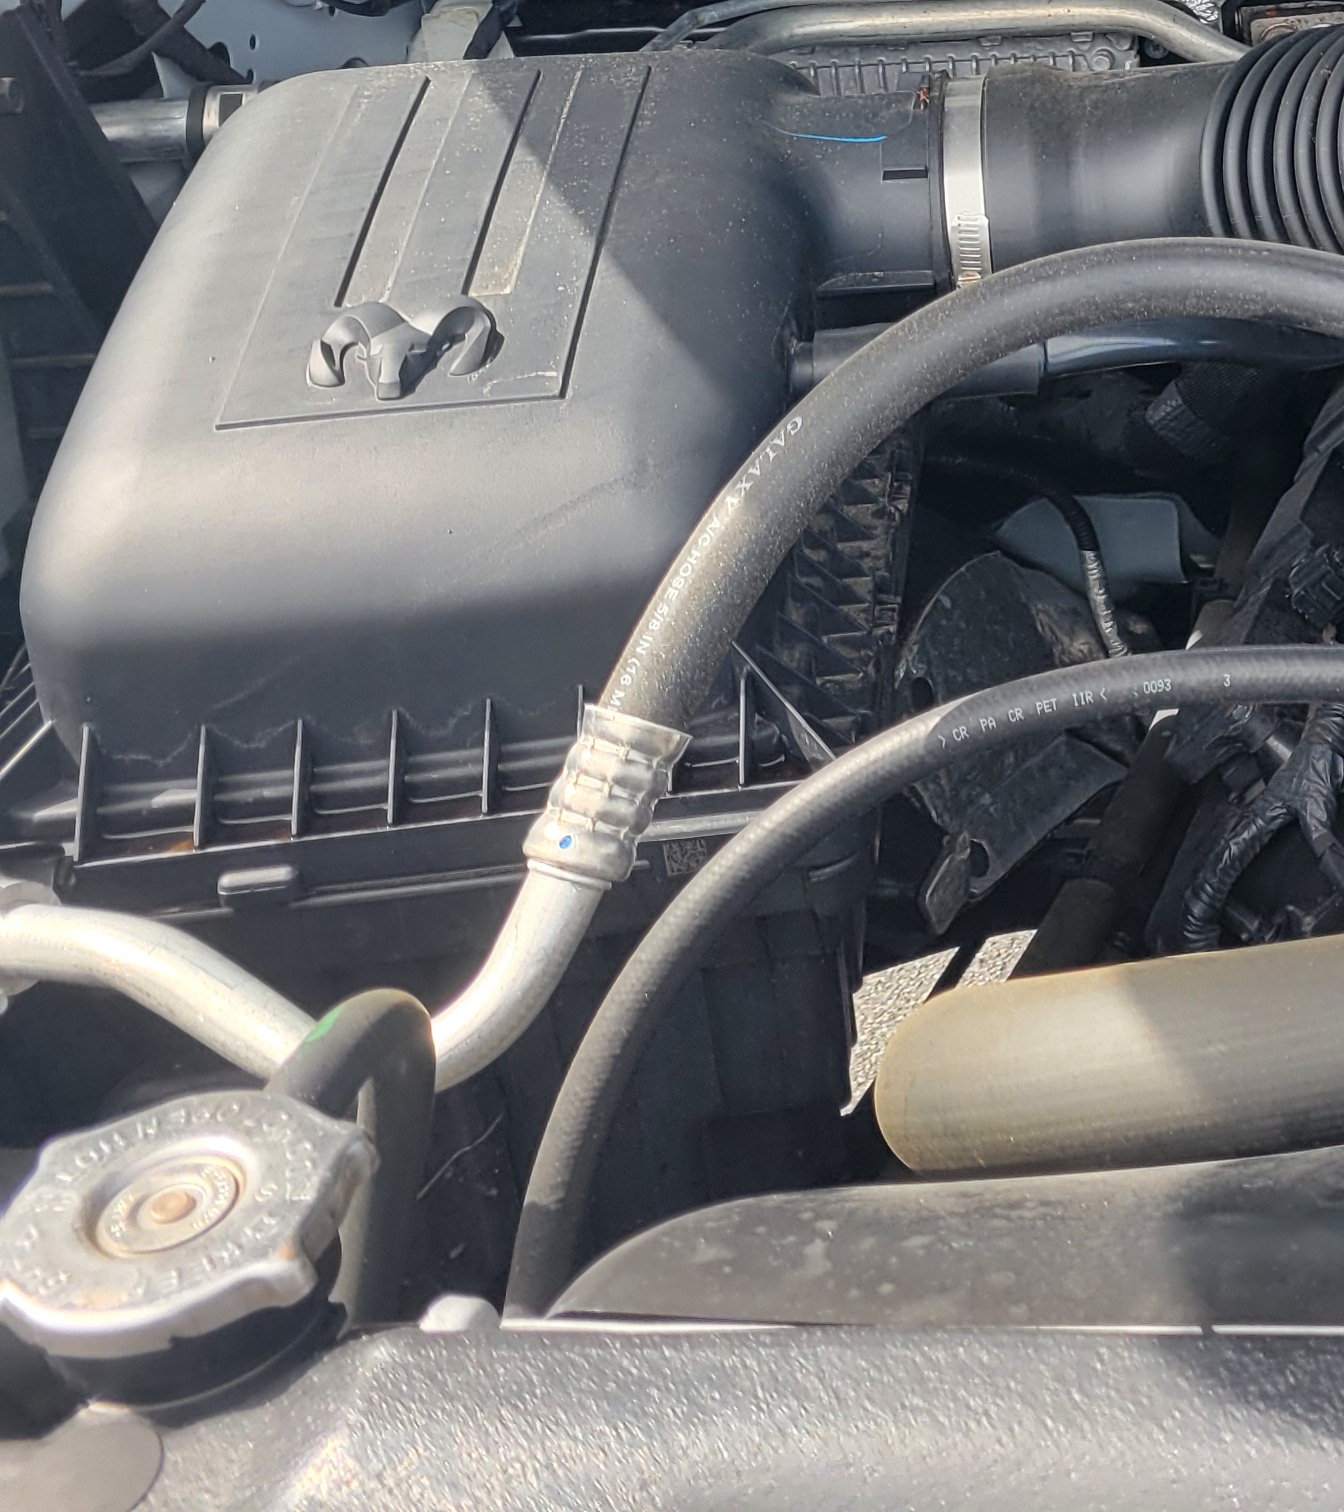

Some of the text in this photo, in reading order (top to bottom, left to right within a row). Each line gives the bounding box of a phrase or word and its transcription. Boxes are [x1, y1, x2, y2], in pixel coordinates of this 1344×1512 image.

[724, 415, 805, 515] GALAXY
[666, 549, 702, 602] HOSE
[648, 600, 670, 632] 5/8
[638, 632, 654, 655] IN
[620, 656, 641, 686] (16
[952, 725, 970, 742] CR
[979, 717, 997, 734] PA
[1007, 707, 1024, 723] CR
[1035, 698, 1058, 716] PET
